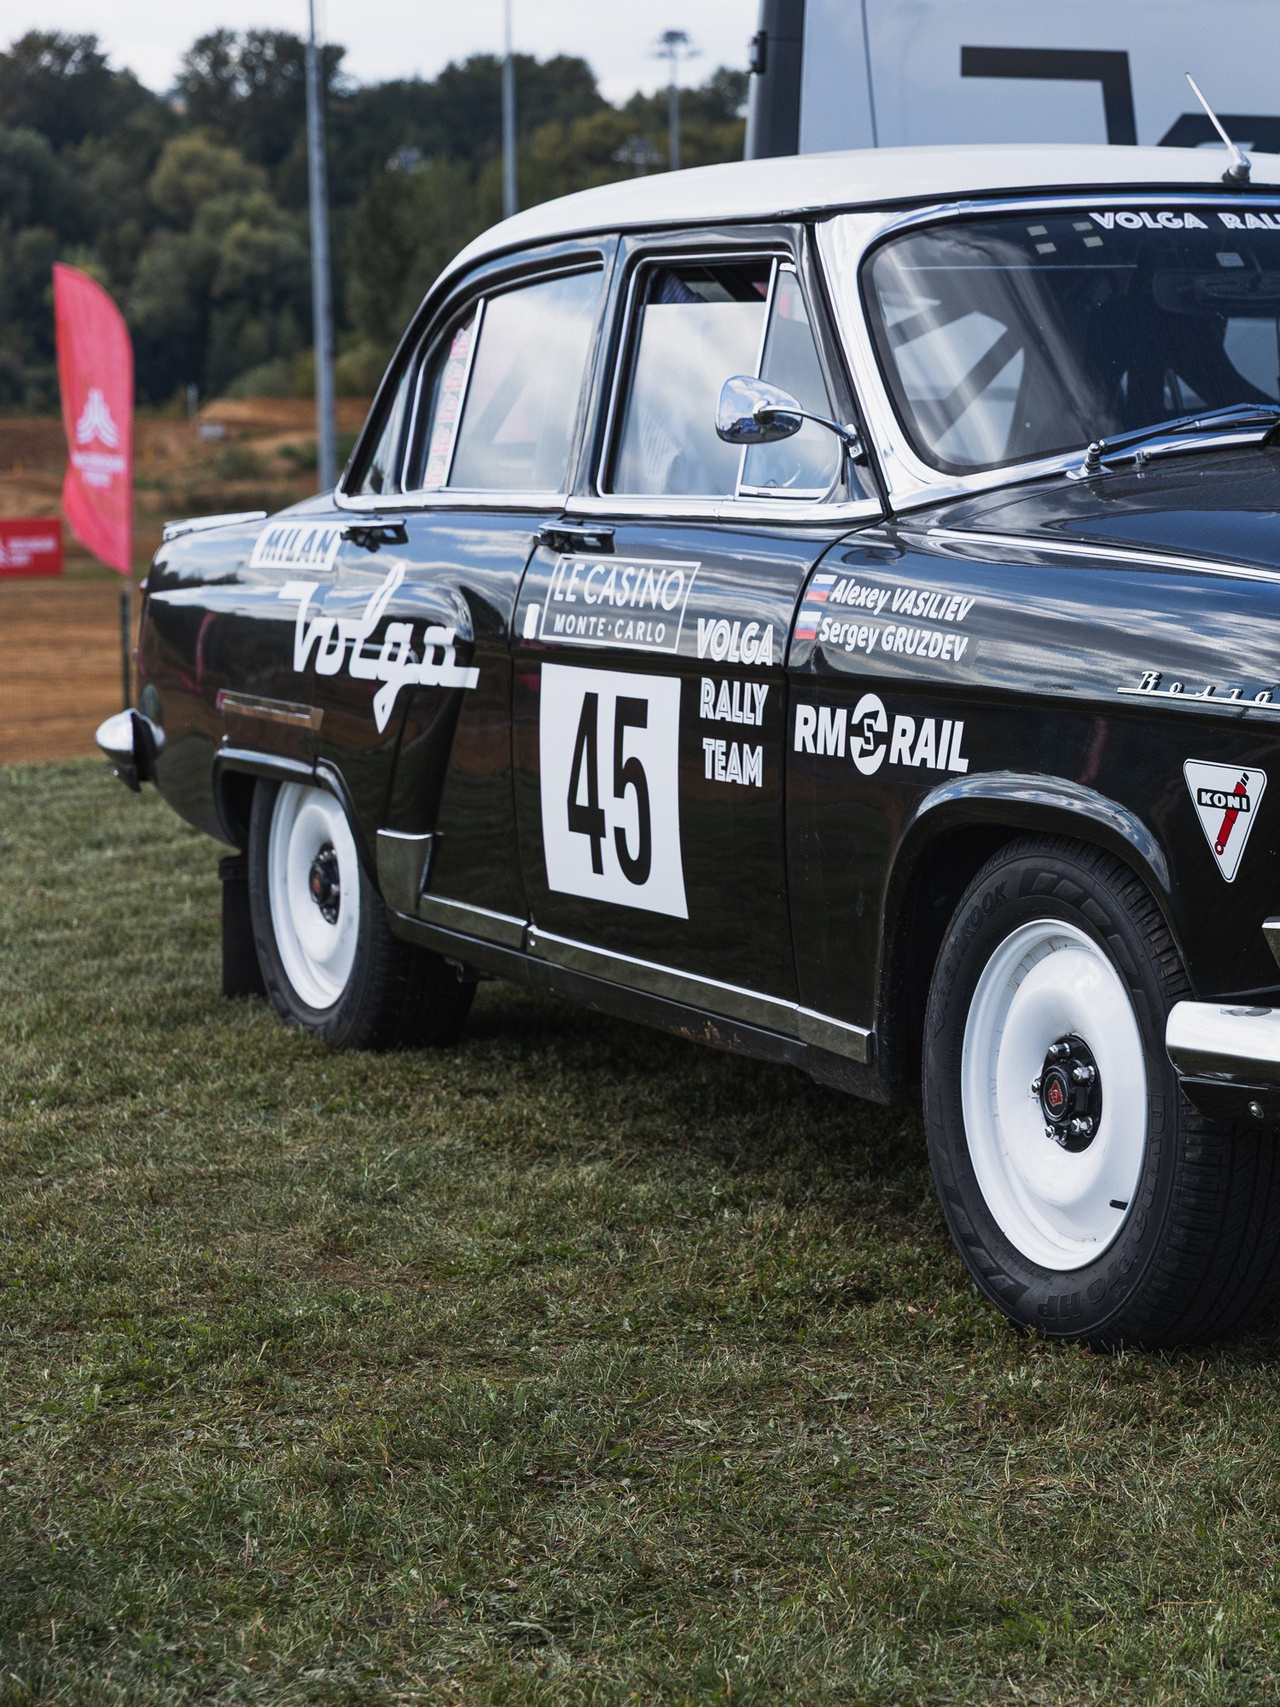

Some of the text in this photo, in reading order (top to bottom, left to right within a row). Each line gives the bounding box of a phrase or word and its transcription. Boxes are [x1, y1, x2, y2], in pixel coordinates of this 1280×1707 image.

[1088, 211, 1208, 230] VOLGA
[259, 527, 339, 565] MILAN
[553, 562, 685, 611] LE CASINO
[828, 578, 976, 622] Alexey VASILIEV
[277, 560, 481, 735] Volga
[697, 617, 774, 667] VOLGA
[818, 616, 969, 662] Sergey GRUZDEV
[699, 677, 770, 726] RALLY
[702, 737, 763, 787] TEAM
[566, 691, 652, 887] 45
[1200, 791, 1248, 810] KONI
